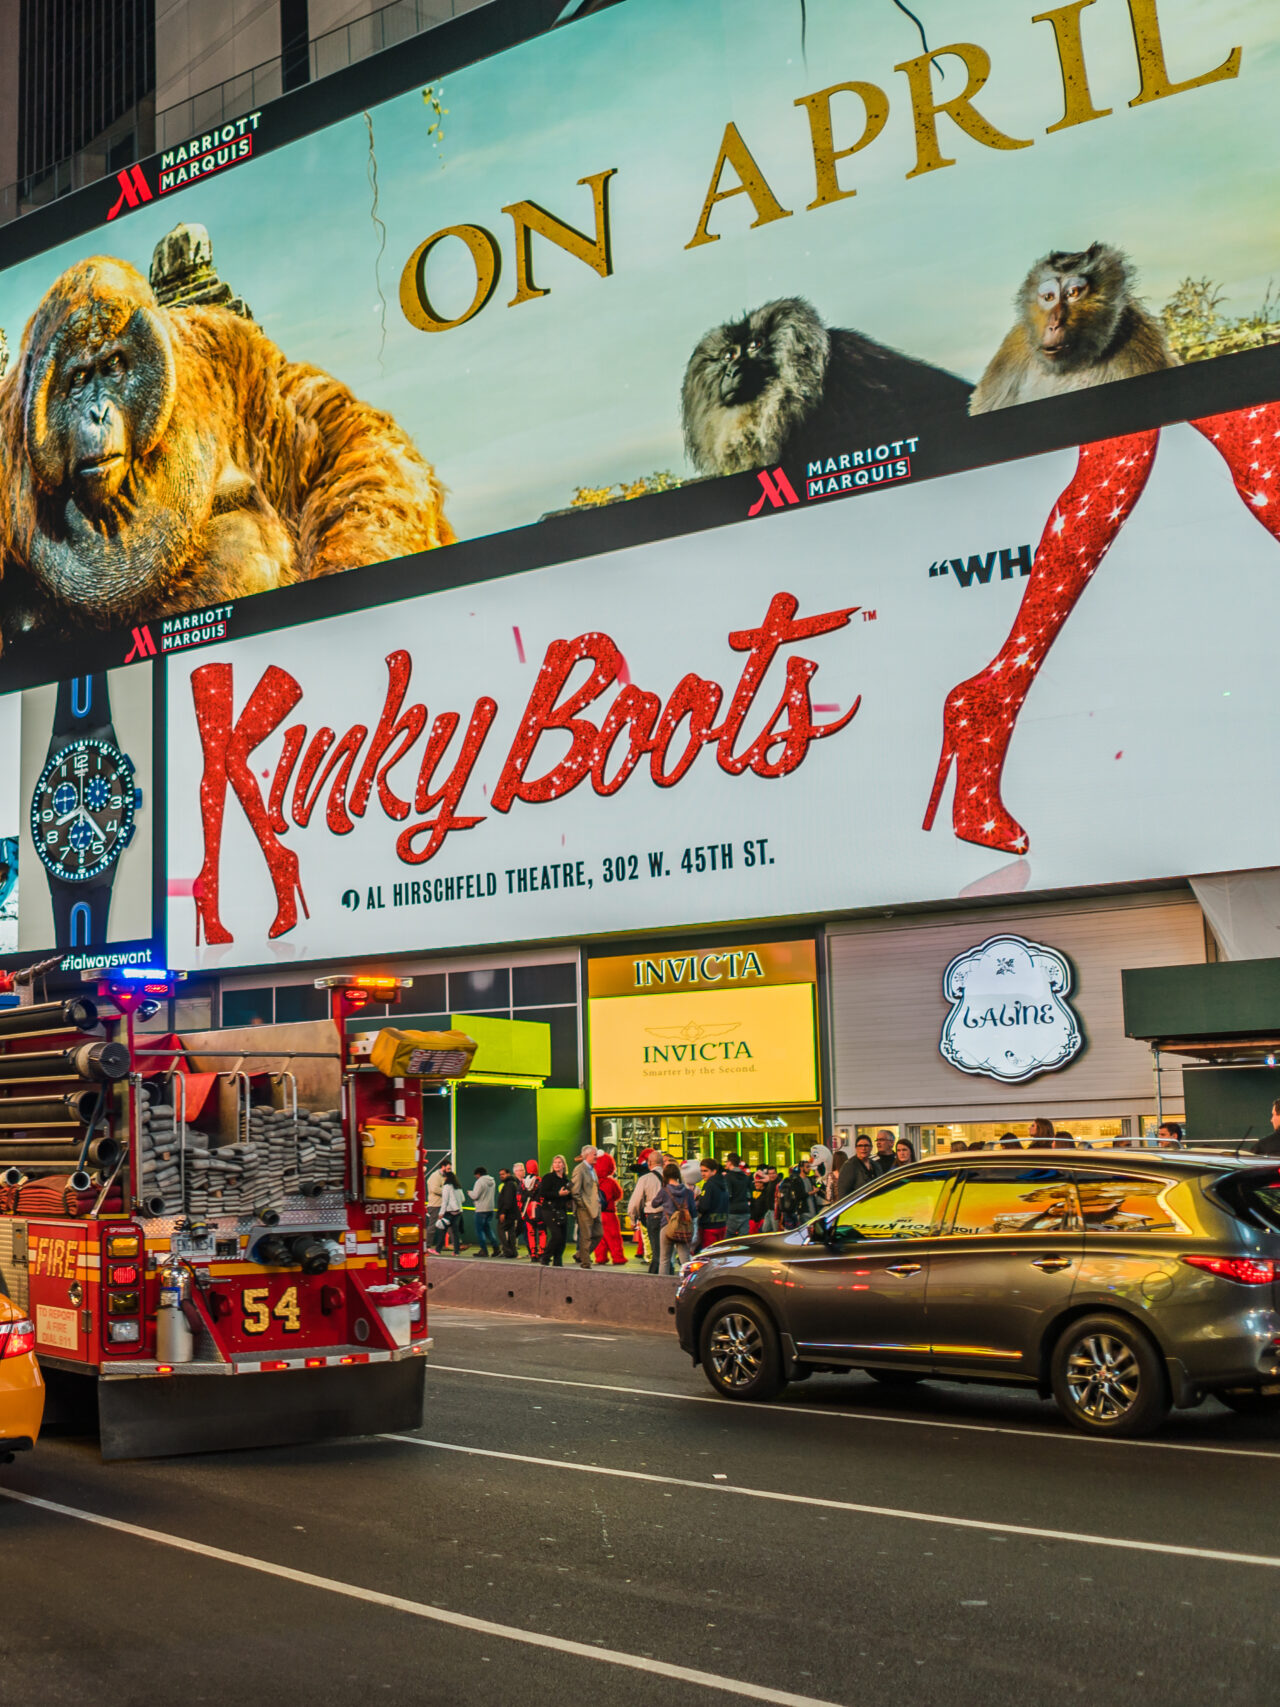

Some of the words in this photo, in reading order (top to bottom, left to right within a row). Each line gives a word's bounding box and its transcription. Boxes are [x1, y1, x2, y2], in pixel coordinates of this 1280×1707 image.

[161, 111, 262, 170] MARRIOTT
[161, 139, 250, 190] MARQUIS
[398, 167, 618, 333] ON
[683, 0, 1244, 250] APRIL
[807, 436, 919, 478] MARRIOTT
[809, 460, 908, 497] MARQUIS
[163, 605, 234, 634] MARRIOTT
[163, 623, 225, 650] MARQUIS
[190, 650, 498, 948] Kinky
[492, 592, 862, 814] Boots
[109, 795, 123, 810] 3
[41, 809, 54, 822] 9
[105, 819, 118, 833] 4
[45, 830, 59, 844] 8
[92, 841, 105, 855] 5
[59, 846, 71, 861] 7
[366, 885, 386, 910] AL
[393, 872, 497, 908] HIRSCHFELD
[505, 861, 594, 895] THEATRE,
[602, 855, 639, 883] 302
[648, 851, 671, 877] W.
[681, 844, 734, 874] 45TH
[743, 838, 776, 867] ST.
[61, 948, 152, 972] #ialwayswant
[633, 951, 764, 986] INVICTA
[643, 1041, 754, 1064] INVICTA
[642, 1069, 681, 1077] Smarter
[685, 1067, 695, 1077] by
[700, 1066, 715, 1075] the
[364, 1203, 387, 1214] 200
[388, 1202, 414, 1214] FEET
[36, 1237, 79, 1279] FIRE
[38, 1306, 49, 1316] TO
[50, 1307, 75, 1320] REPORT
[242, 1286, 301, 1335] 54
[41, 1333, 58, 1343] DIAL
[46, 1323, 51, 1331] A
[51, 1324, 67, 1334] FIRE
